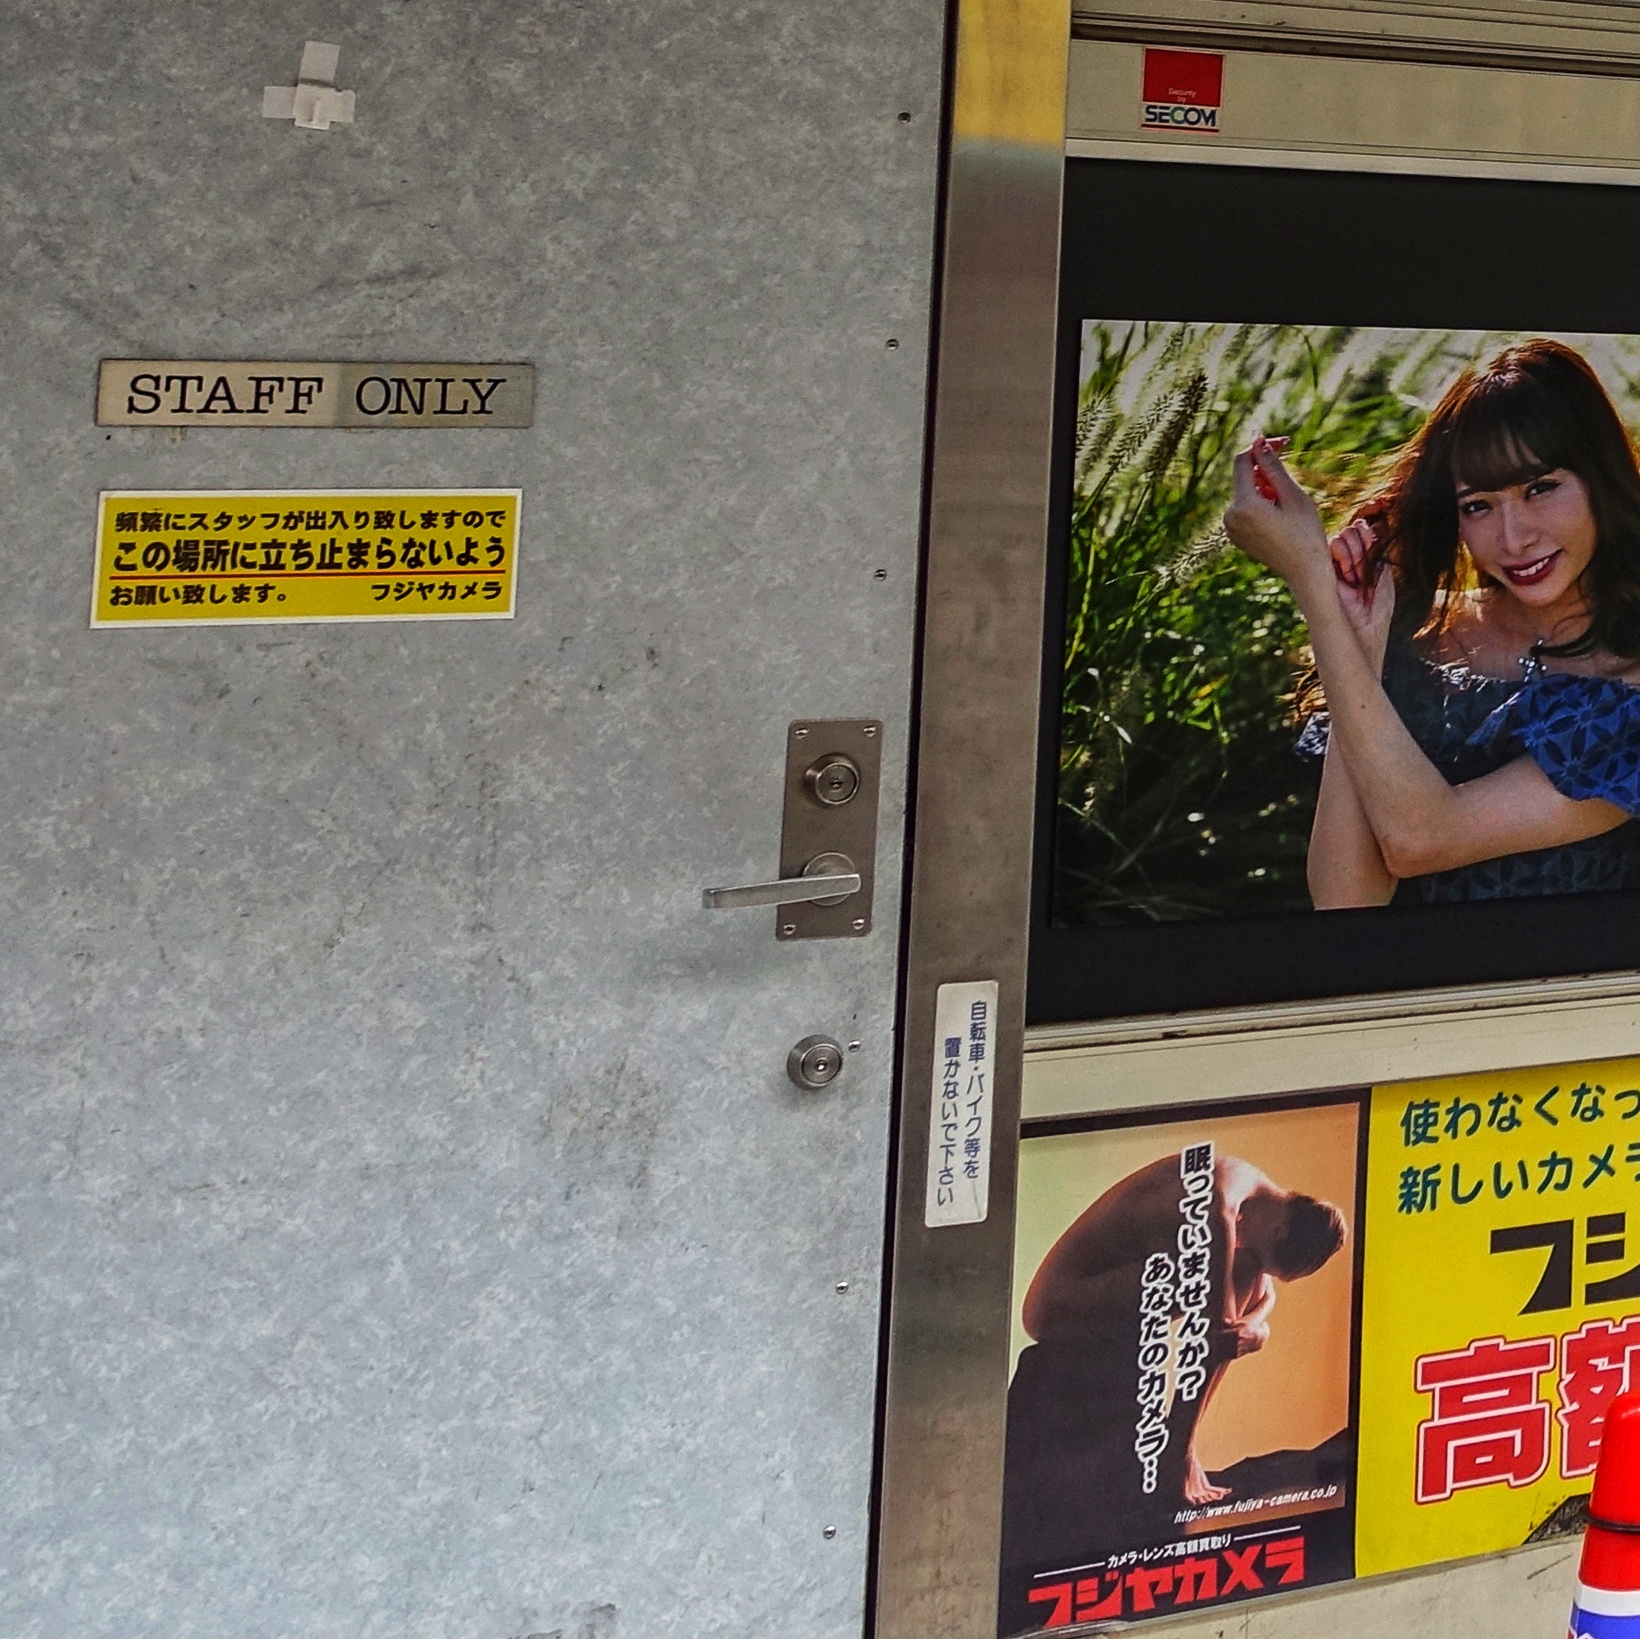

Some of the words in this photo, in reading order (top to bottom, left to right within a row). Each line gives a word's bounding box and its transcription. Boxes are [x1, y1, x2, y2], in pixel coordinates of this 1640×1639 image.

[1145, 105, 1217, 127] SECOM
[125, 373, 324, 415] STAFF
[354, 376, 507, 416] ONLY
[114, 508, 507, 533] 頻繁にスタッフが出入り致しますので
[112, 536, 507, 573] この場所に立ち止まらないよう
[109, 582, 288, 606] お願い致します。
[370, 580, 503, 602] フジヤカメラ
[963, 1001, 988, 1180] 自転車・バイク等を
[935, 1038, 963, 1207] 置かないで下さい
[1174, 1142, 1215, 1400] 眠っていませんか?
[1028, 1536, 1305, 1631] フジヤカメラ
